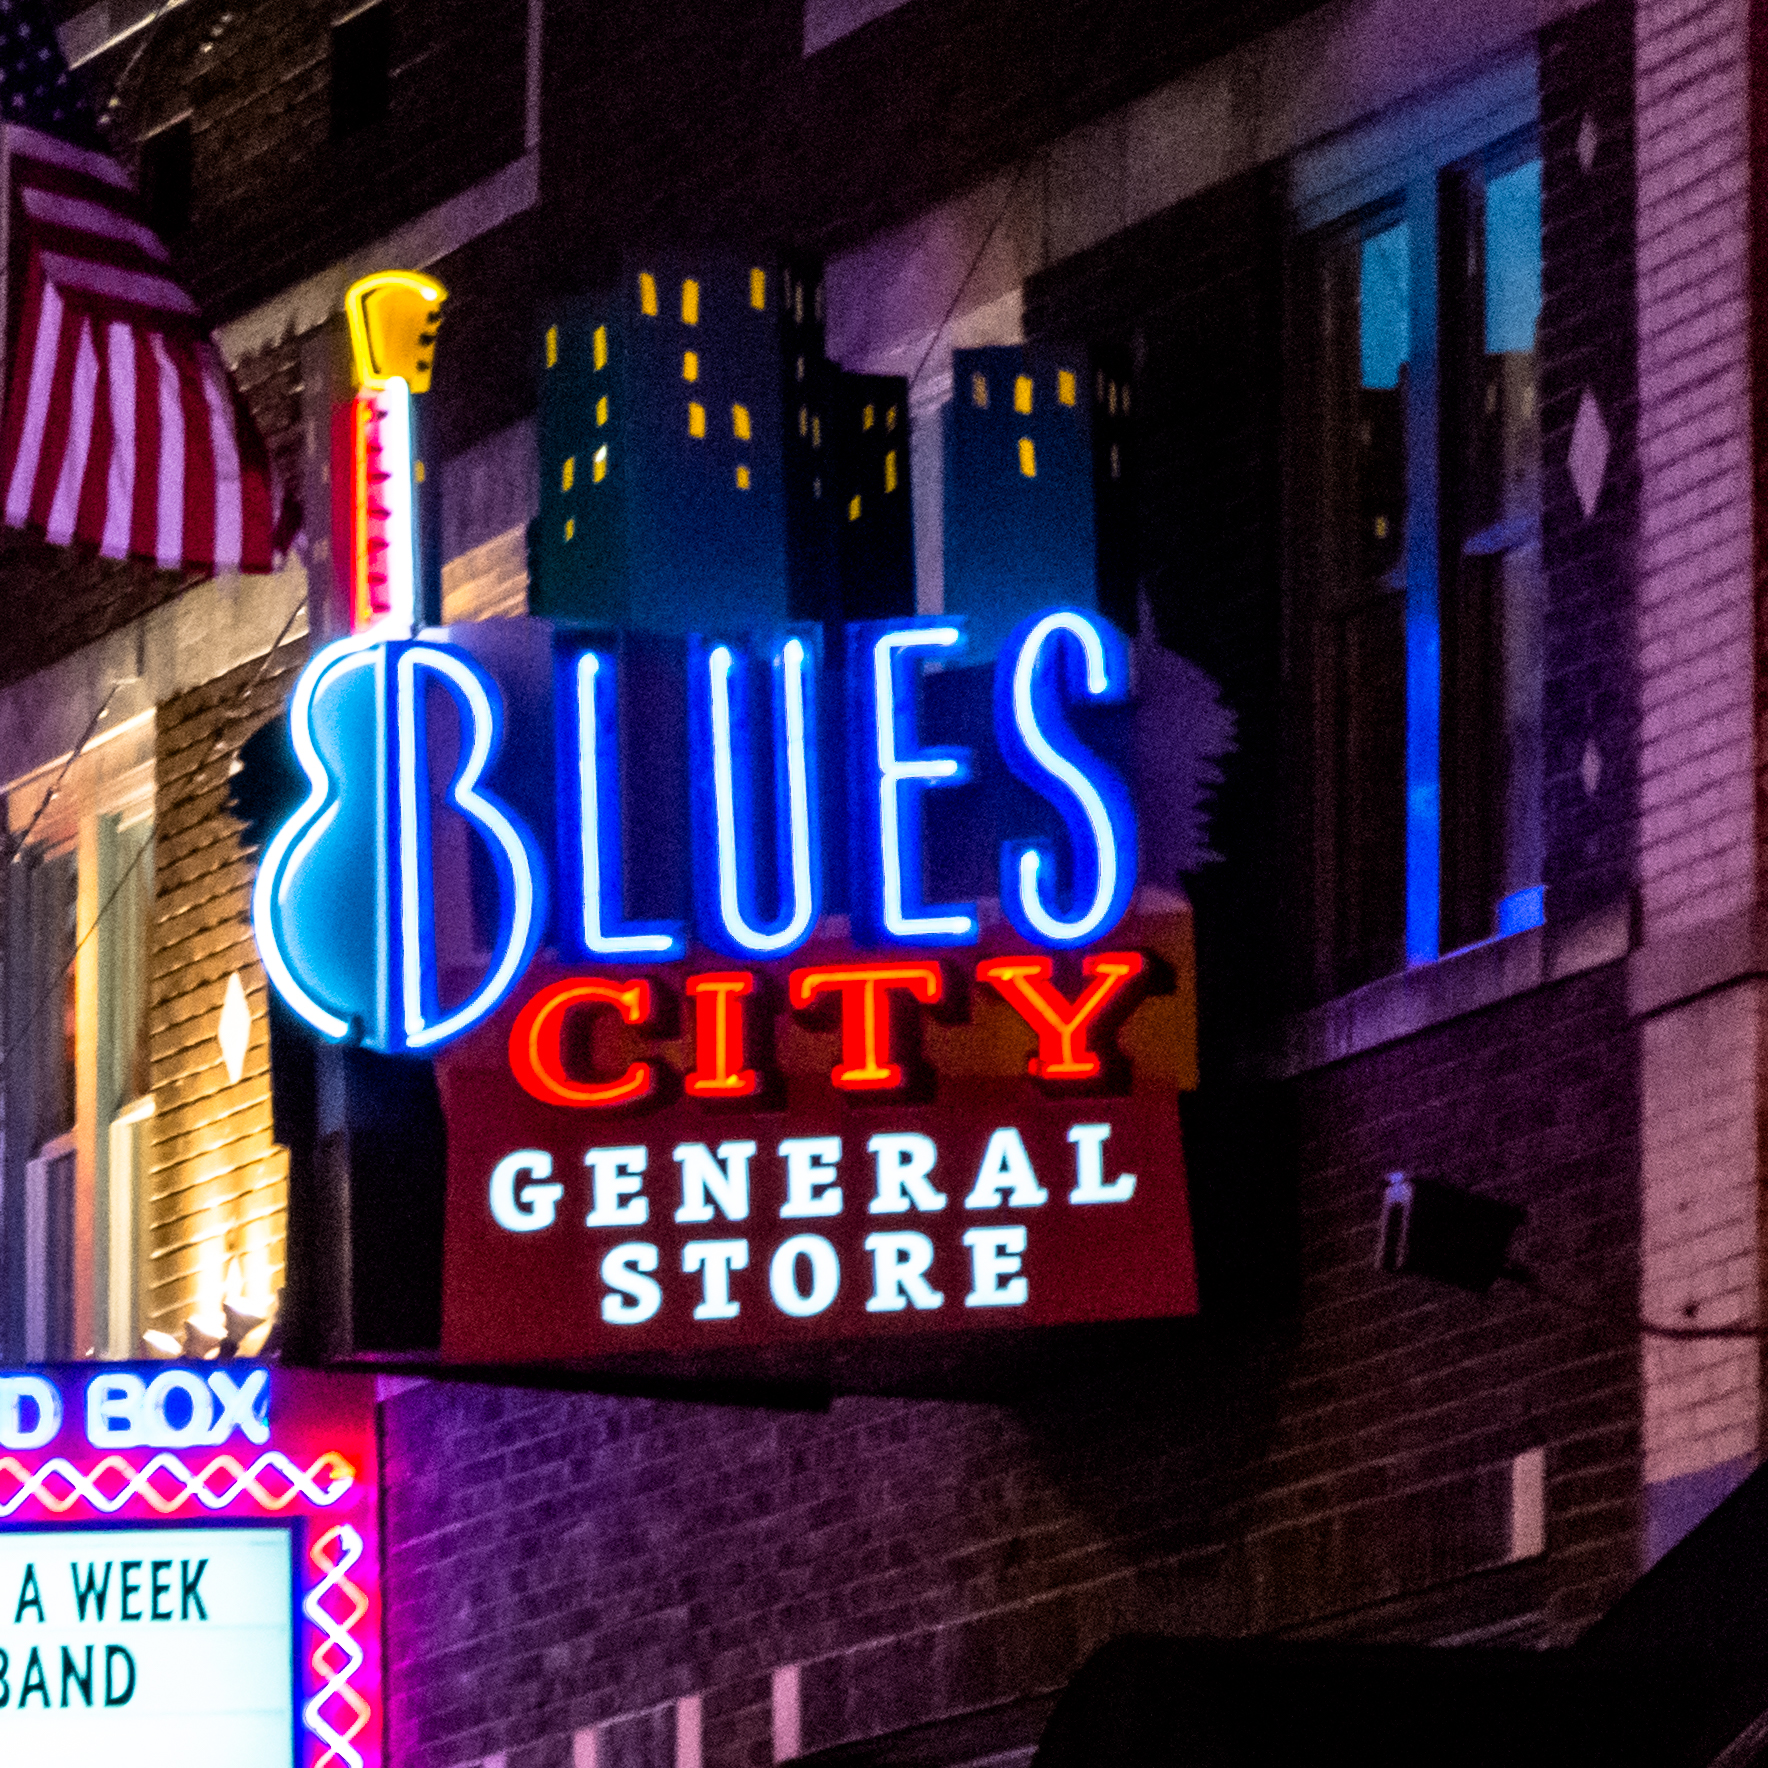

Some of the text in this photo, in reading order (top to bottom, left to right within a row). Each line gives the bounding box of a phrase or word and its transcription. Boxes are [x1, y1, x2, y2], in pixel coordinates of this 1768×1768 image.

[389, 610, 1132, 1053] BLUES
[508, 950, 1144, 1110] CITY
[487, 1121, 1138, 1232] GENERAL
[600, 1224, 1030, 1326] STORE
[86, 1369, 271, 1449] BOX
[14, 1562, 46, 1624] A
[70, 1558, 209, 1622] WEEK
